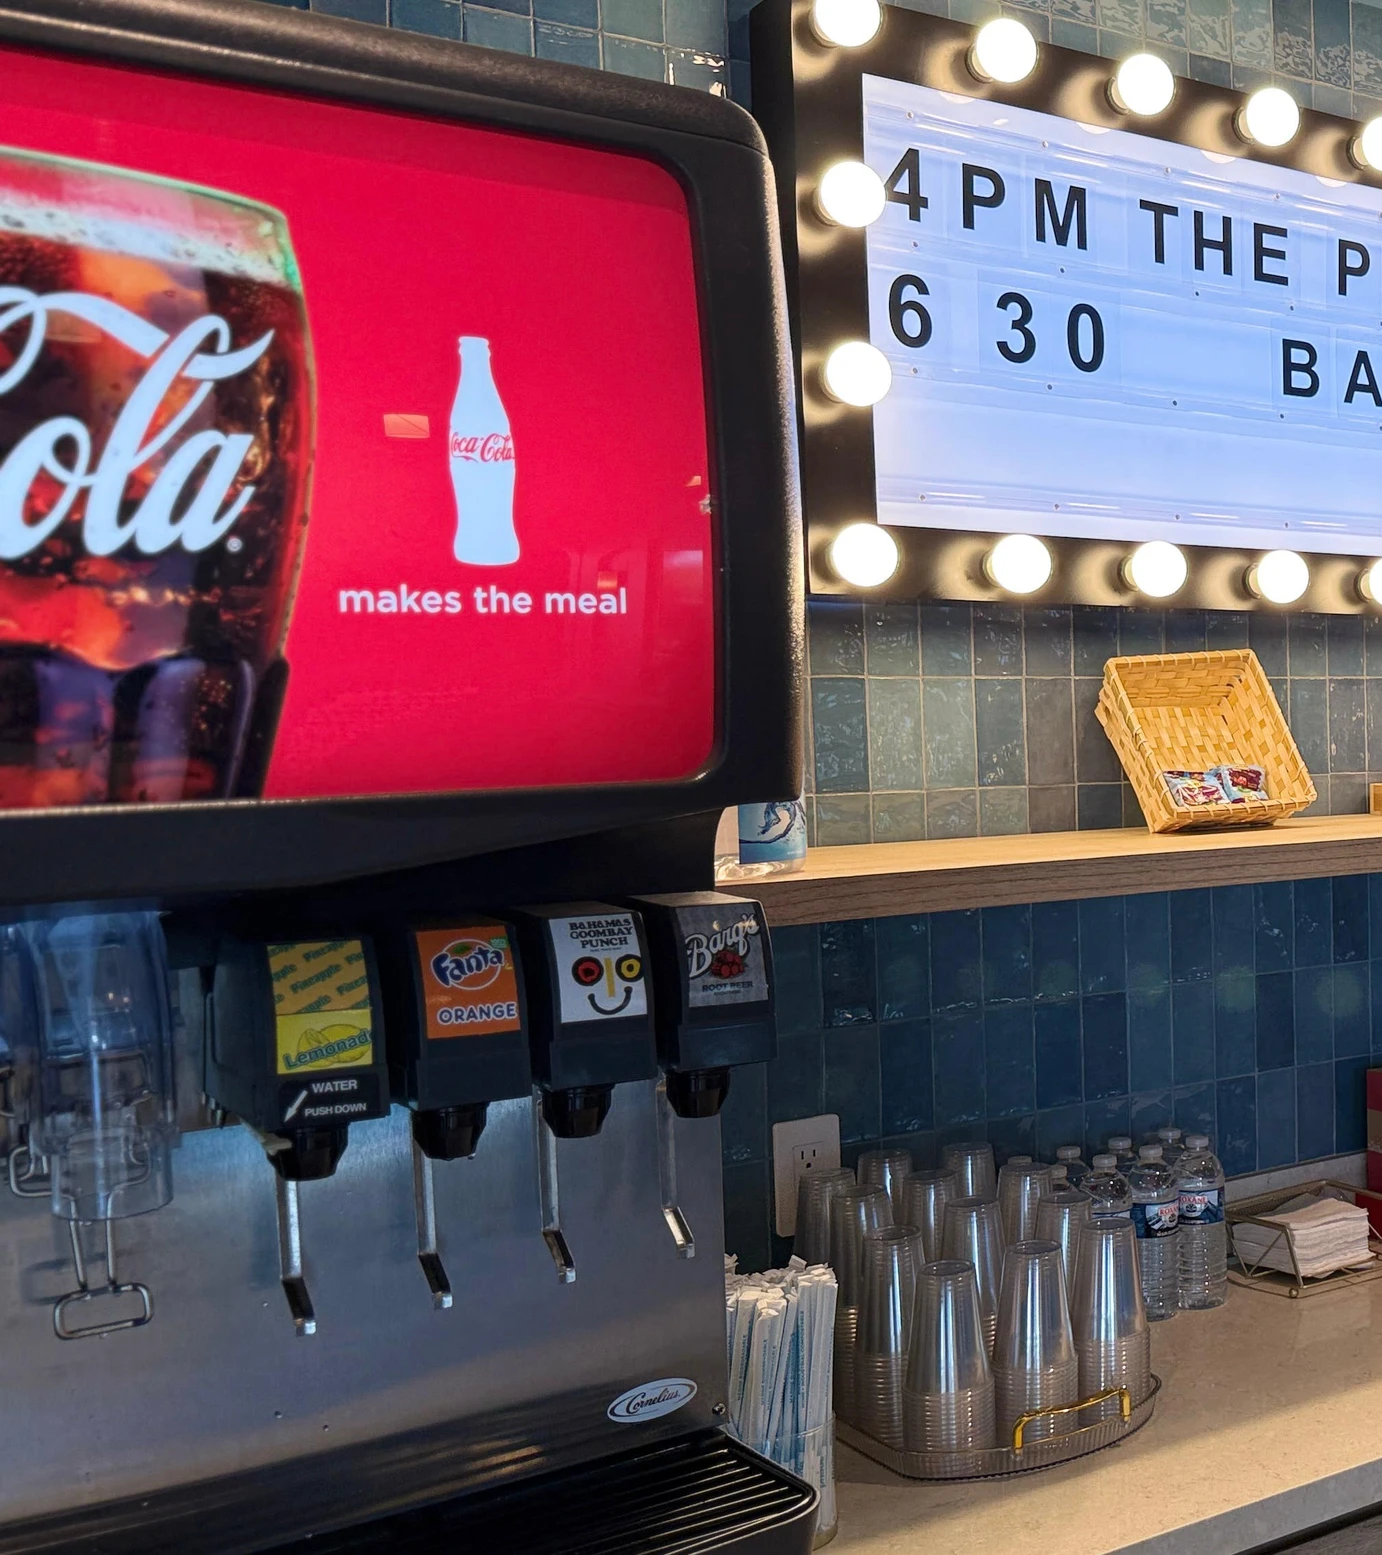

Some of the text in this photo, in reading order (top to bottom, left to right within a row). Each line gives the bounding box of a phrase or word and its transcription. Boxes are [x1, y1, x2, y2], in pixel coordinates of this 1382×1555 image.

[885, 147, 1088, 251] 4PM
[1139, 199, 1289, 286] THE
[888, 273, 933, 348] 6
[995, 291, 1105, 374] 30
[339, 583, 627, 614] makes the meal
[570, 926, 633, 940] GOOMBAY
[580, 937, 629, 949] PUNCH
[684, 912, 760, 979] Barq's
[289, 963, 343, 994] Pineapple
[431, 946, 505, 987] Fanta
[702, 982, 728, 993] ROOT
[437, 1002, 518, 1025] ORANGE
[312, 1079, 358, 1094] WATER
[304, 1102, 367, 1118] PUSH DOWN
[625, 1387, 680, 1415] Cornelius
